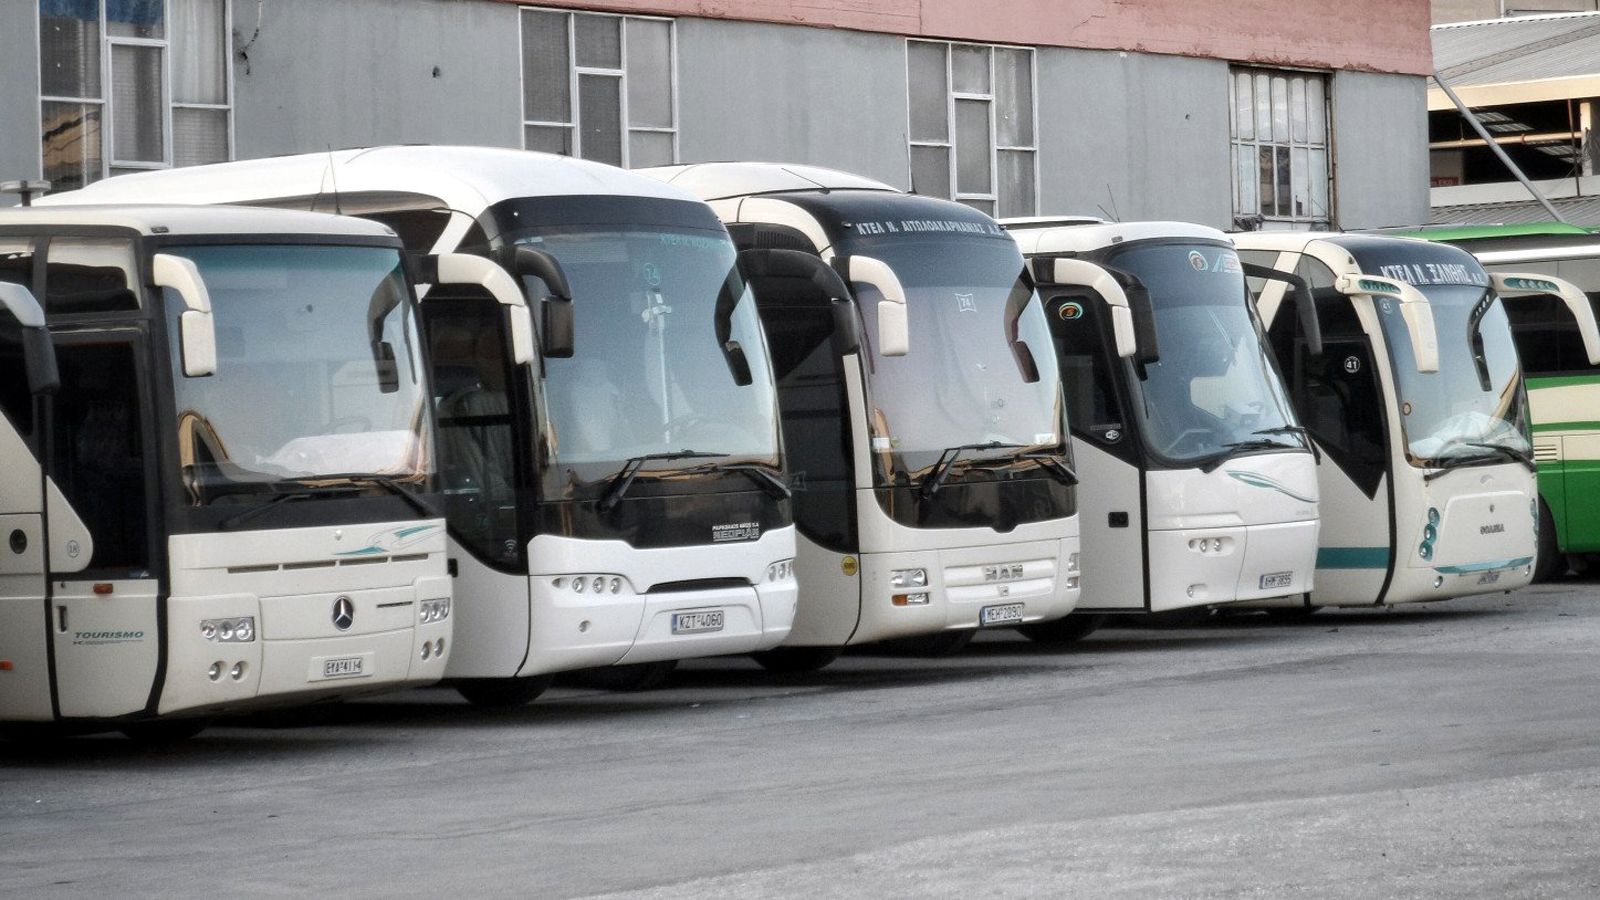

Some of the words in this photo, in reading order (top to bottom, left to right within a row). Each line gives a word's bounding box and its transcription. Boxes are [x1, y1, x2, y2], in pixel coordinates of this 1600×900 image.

[855, 222, 885, 235] ΚΤΕΛ
[1425, 263, 1472, 283] ΞΑΝΘΗΣ
[960, 298, 971, 307] 74
[1346, 361, 1356, 369] 41
[712, 528, 760, 540] NEOPLAN
[984, 564, 1023, 580] MAN
[74, 631, 144, 639] TOURISMO
